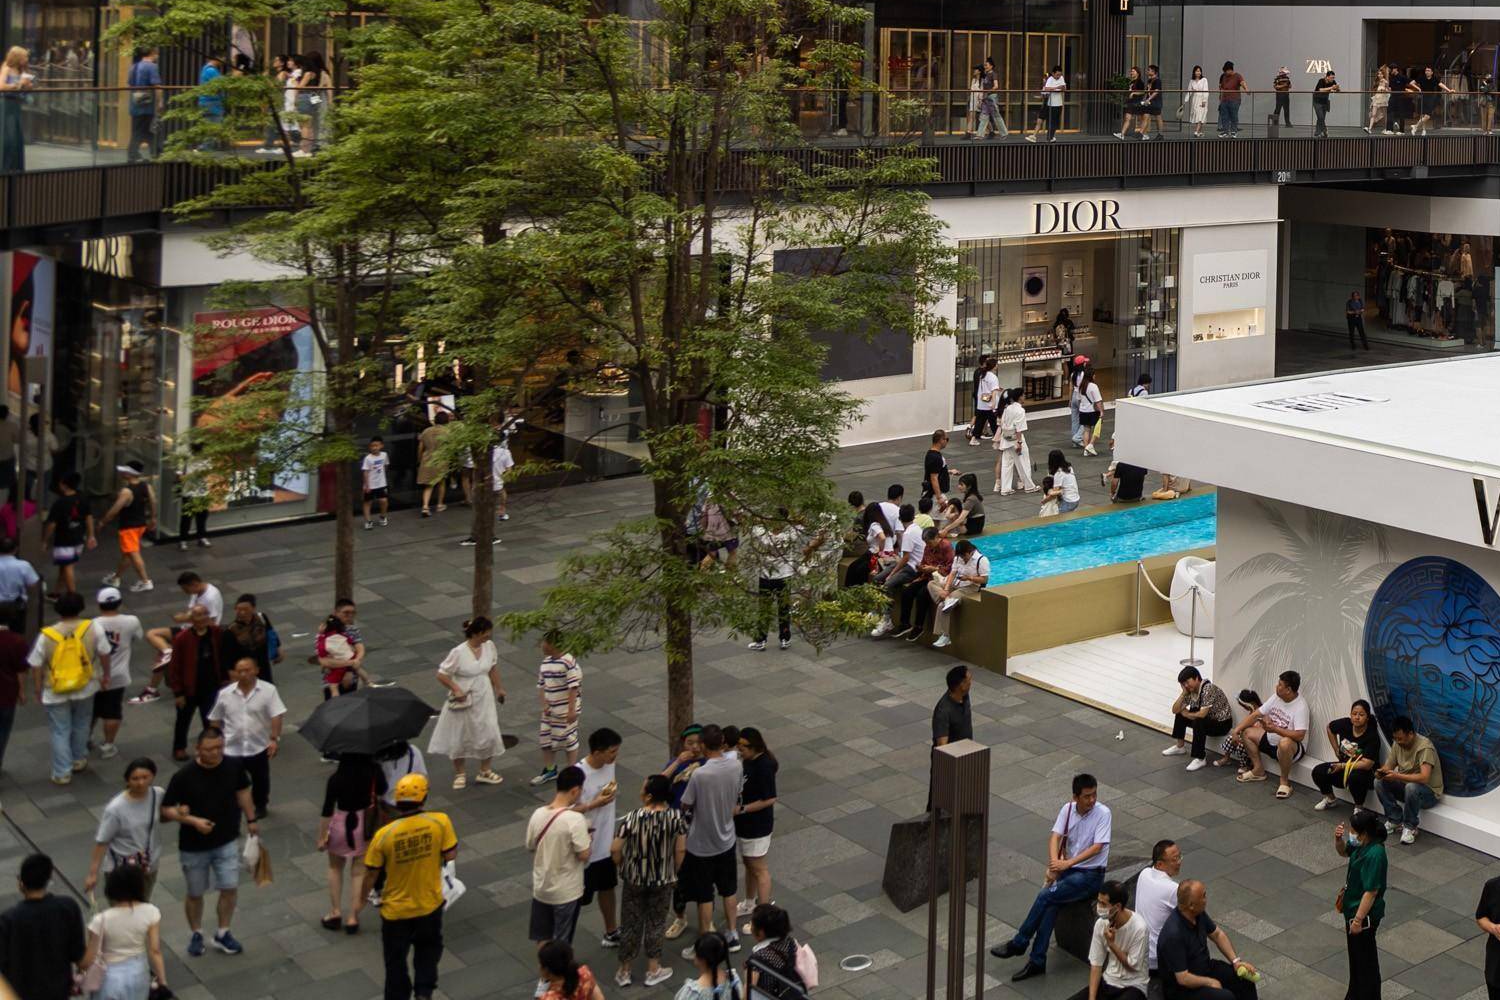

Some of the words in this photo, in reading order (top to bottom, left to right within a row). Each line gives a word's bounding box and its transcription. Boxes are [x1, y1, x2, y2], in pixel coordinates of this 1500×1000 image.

[1306, 59, 1332, 74] ZARA
[1032, 199, 1127, 235] DIOR
[81, 235, 134, 279] DIOR
[1199, 272, 1241, 284] CHRISTIAN
[1241, 271, 1261, 281] DIOR
[1223, 281, 1239, 289] PARIS
